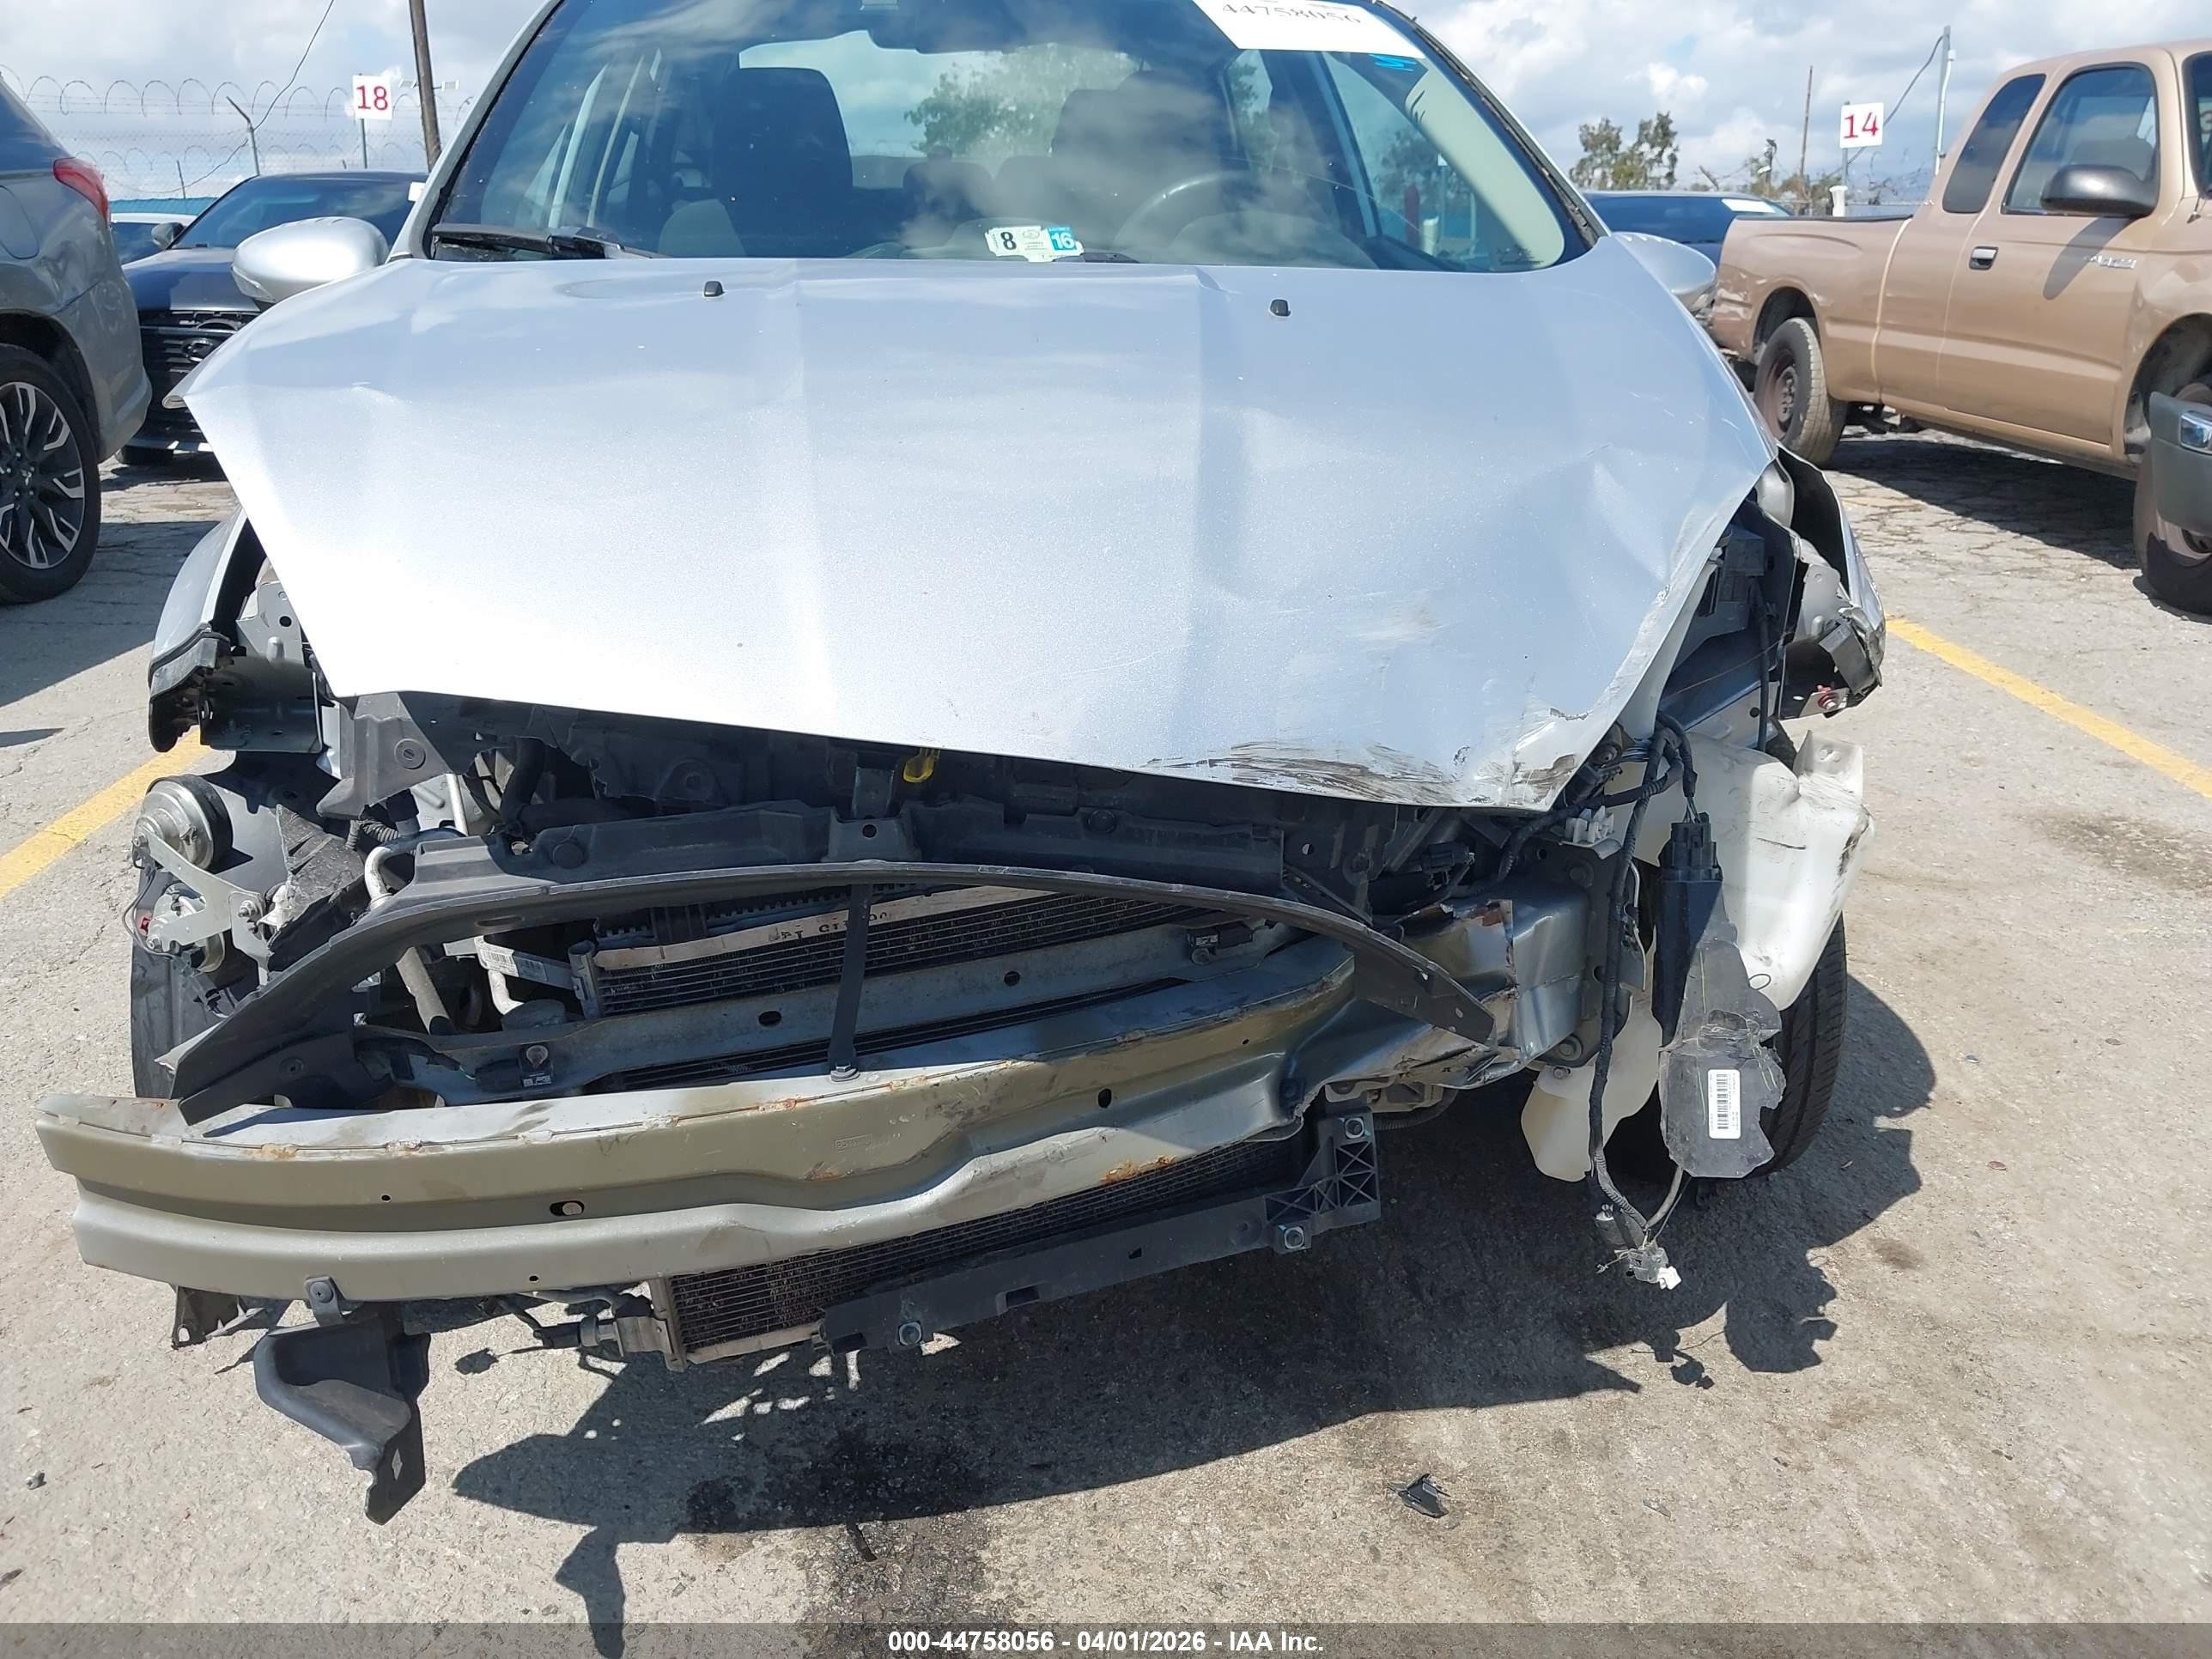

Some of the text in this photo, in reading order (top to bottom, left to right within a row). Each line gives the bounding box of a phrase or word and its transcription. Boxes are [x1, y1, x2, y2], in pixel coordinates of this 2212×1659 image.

[356, 84, 389, 111] 18
[1844, 112, 1880, 138] 14
[1000, 231, 1017, 251] 8
[1050, 231, 1075, 250] 16
